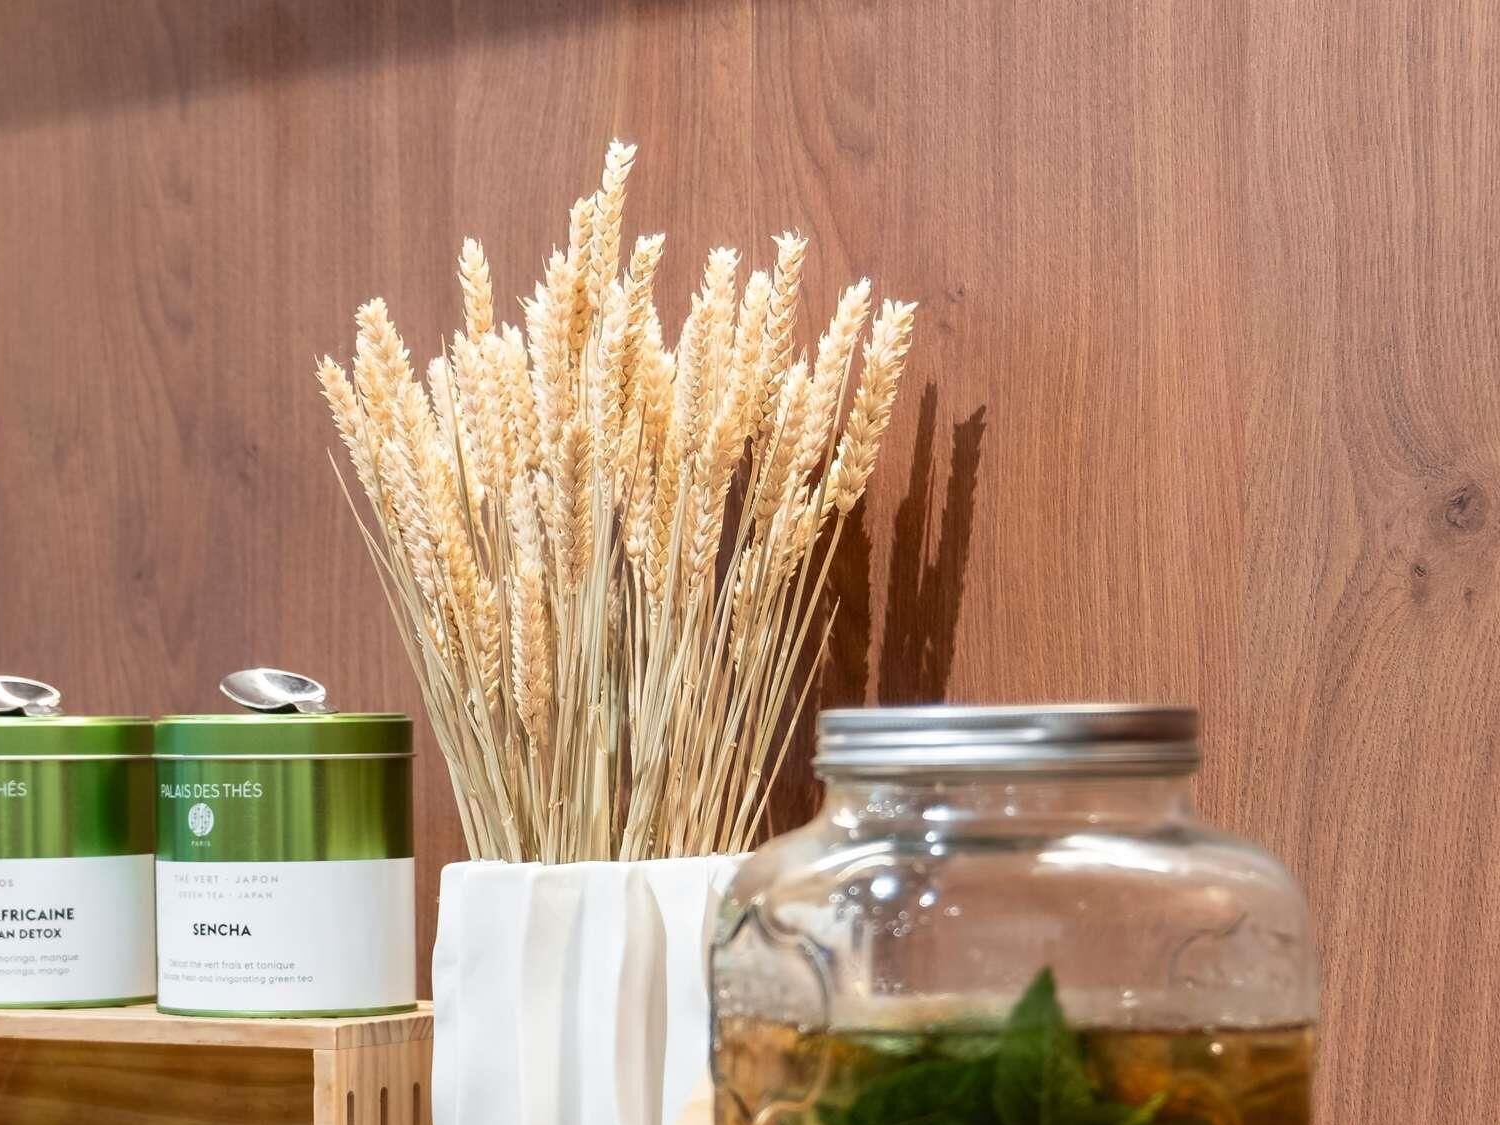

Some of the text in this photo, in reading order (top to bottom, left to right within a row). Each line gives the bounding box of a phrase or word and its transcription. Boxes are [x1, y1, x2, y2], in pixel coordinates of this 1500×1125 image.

[160, 783, 191, 798] PALAIS
[194, 783, 220, 798] DES
[194, 875, 219, 884] VERT
[236, 875, 279, 884] JAPON
[238, 891, 273, 899] JAPAN
[19, 928, 62, 939] DETOX
[192, 923, 252, 936] SENCHA
[40, 952, 79, 963] mangue
[244, 961, 254, 969] et
[256, 960, 296, 971] tonique
[268, 975, 295, 985] green
[297, 975, 314, 983] tea
